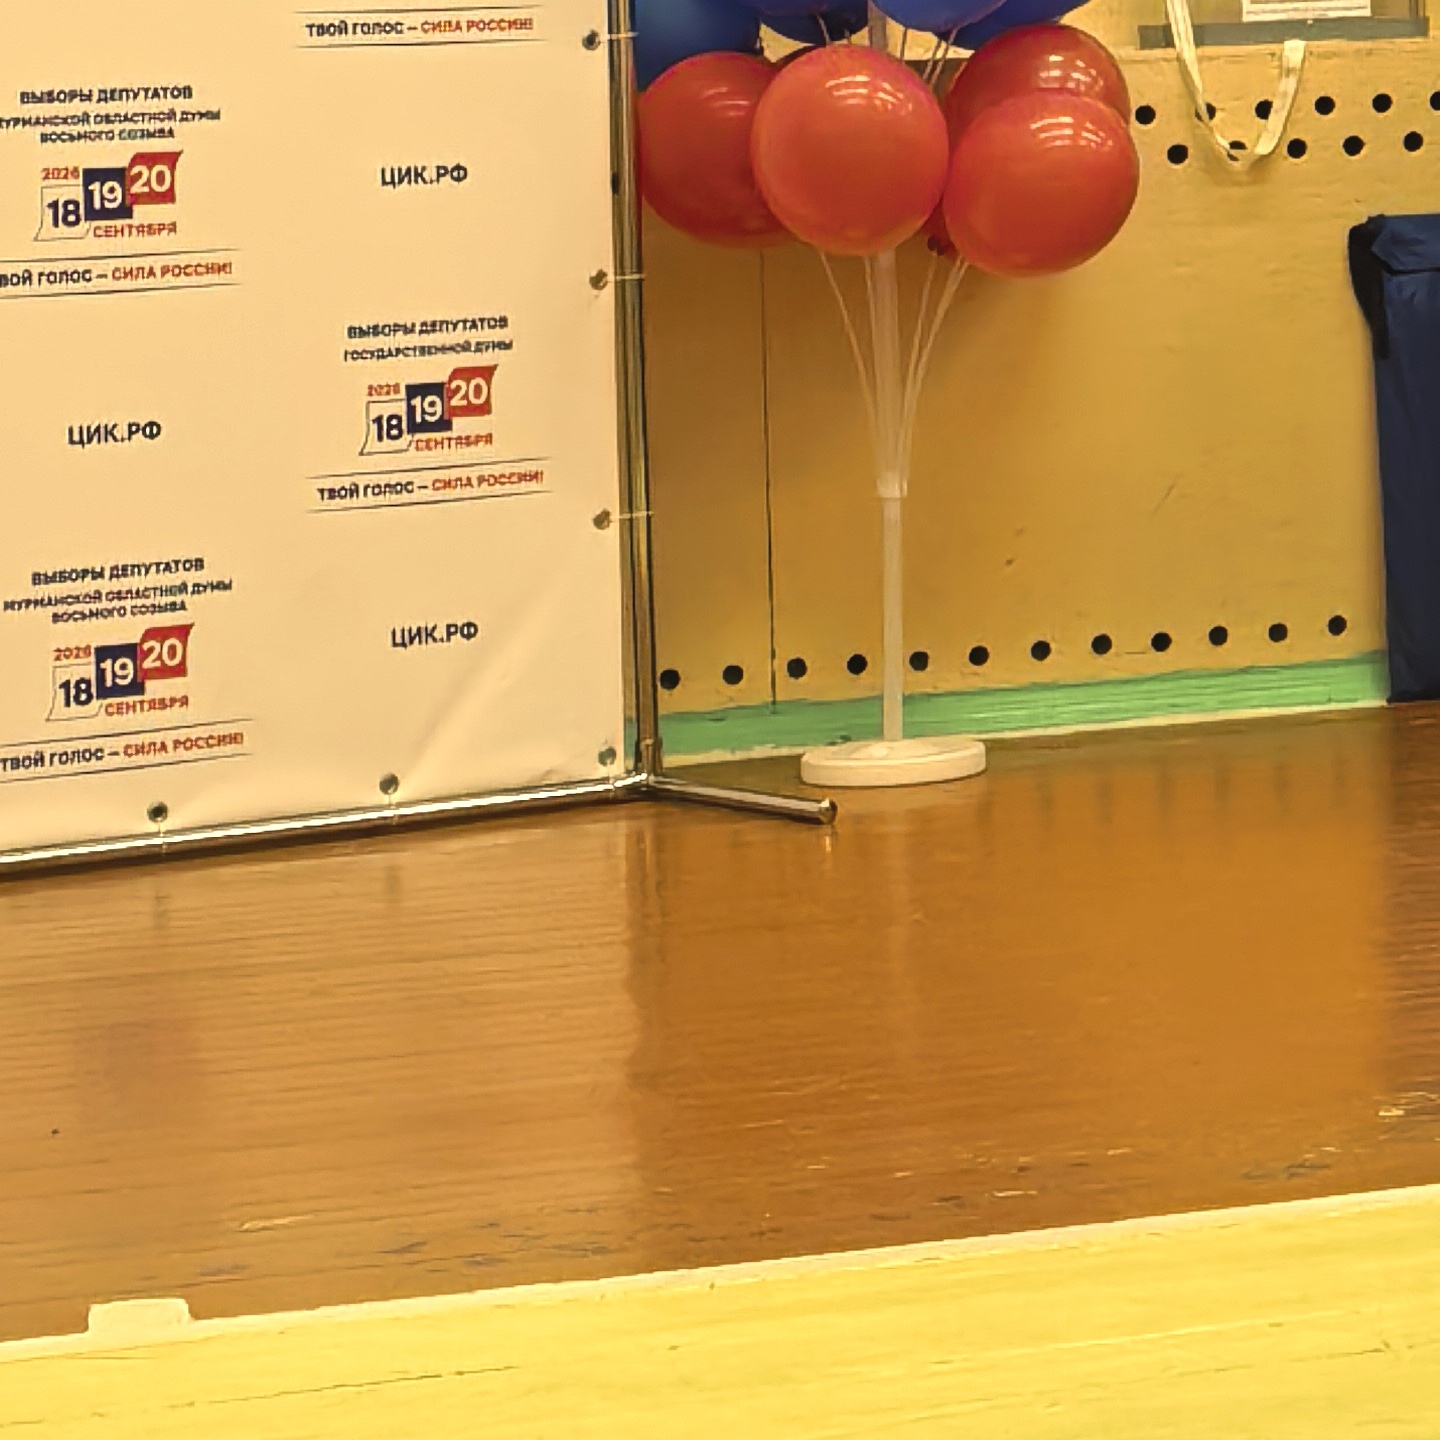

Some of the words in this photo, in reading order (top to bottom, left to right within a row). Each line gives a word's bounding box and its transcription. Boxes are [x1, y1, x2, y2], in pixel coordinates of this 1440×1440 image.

[306, 20, 348, 37] ТВОЙ
[352, 22, 404, 35] ГОЛОС
[421, 20, 462, 33] СИЛА
[20, 88, 92, 104] ВЫБОРЫ
[96, 85, 193, 103] ДЕПУТАТОВ
[381, 163, 468, 189] ЦИК.РФ
[47, 199, 81, 228] 18
[88, 181, 122, 210] 19
[130, 165, 171, 193] 20
[93, 221, 176, 238] СЕНТЯБРЯ
[0, 269, 32, 287] ВОЙ
[38, 270, 92, 287] ГОЛОС
[112, 266, 156, 282] СИЛА
[347, 322, 416, 339] ВЫБОРЫ
[419, 315, 508, 335] ДЕПУТАТОВ
[372, 414, 403, 442] 18
[411, 395, 442, 423] 19
[450, 377, 488, 406] 20
[68, 420, 162, 448] ЦИК.РФ
[414, 433, 493, 451] СЕНТЯБРЯ
[317, 483, 360, 501] ТВОЙ
[363, 481, 415, 498] ГОЛОС
[432, 477, 474, 492] СИЛА
[31, 568, 105, 586] ВЫБОРЫ
[109, 558, 204, 582] ДЕПУТАТОВ
[391, 621, 479, 648] ЦИК.РФ
[59, 678, 93, 708] 18
[100, 657, 134, 687] 19
[142, 638, 182, 669] 20
[105, 695, 189, 716] СЕНТЯБРЯ
[0, 750, 45, 771] ТВОЙ
[50, 748, 104, 766] ГОЛОС
[123, 740, 168, 757] СИЛА
